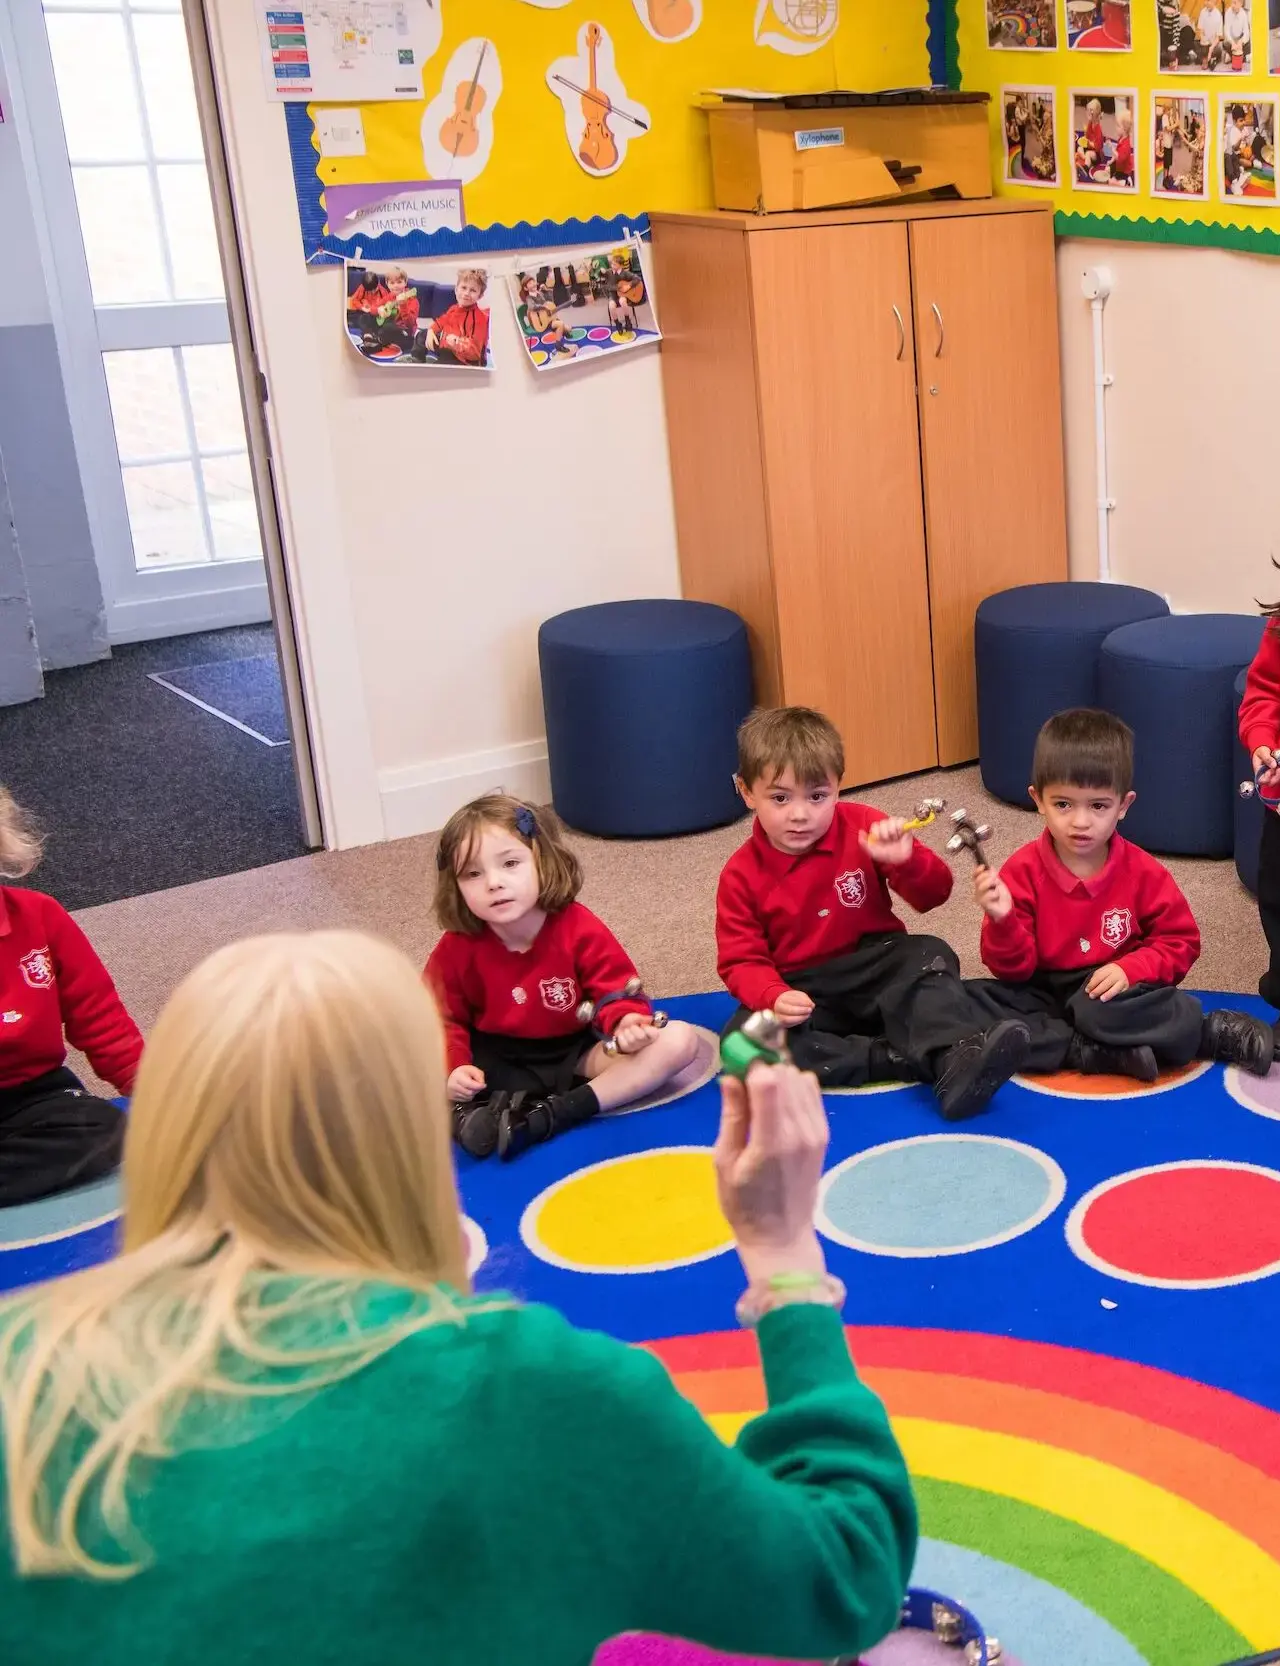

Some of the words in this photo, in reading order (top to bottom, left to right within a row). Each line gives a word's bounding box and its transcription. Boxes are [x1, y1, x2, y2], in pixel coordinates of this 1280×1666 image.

[800, 132, 840, 147] Xylophone
[421, 198, 457, 211] MUSIC
[370, 216, 428, 231] TIMETABLE
